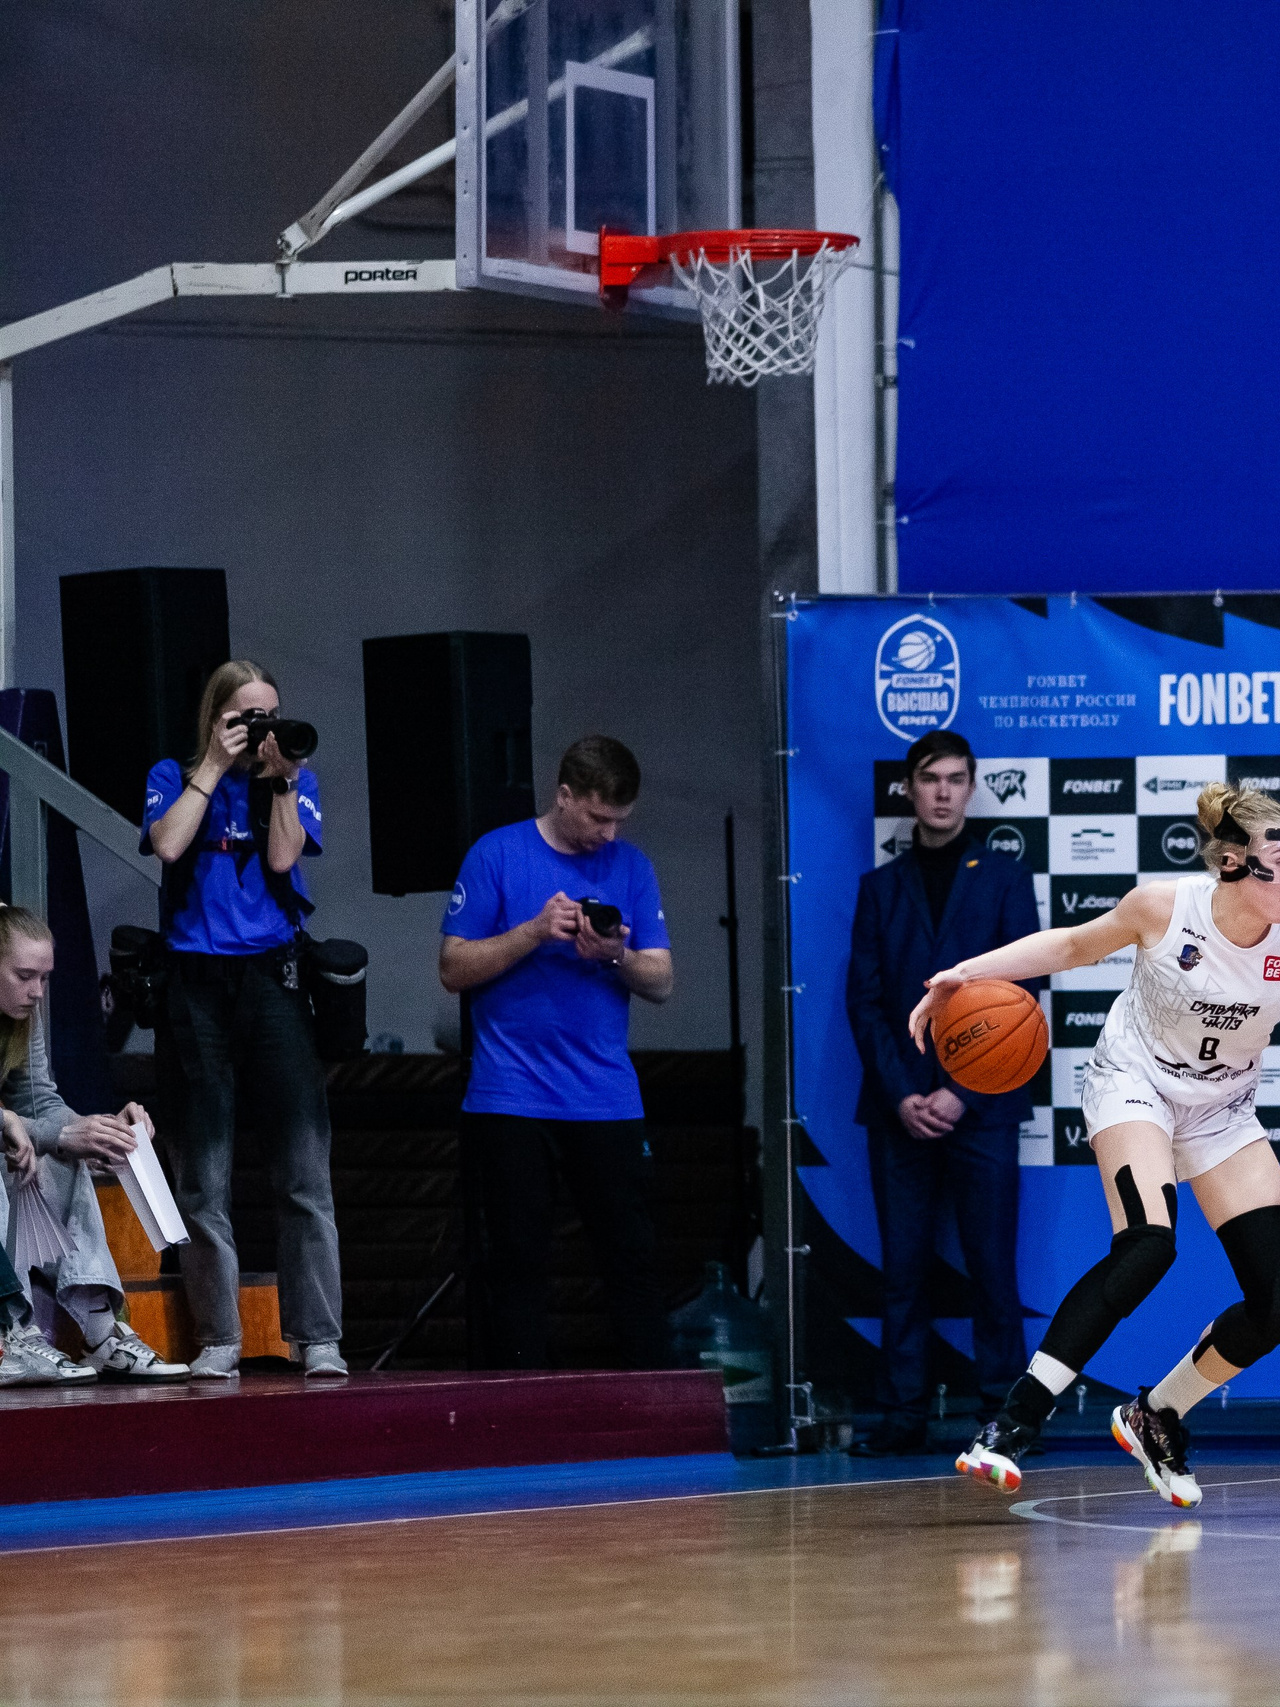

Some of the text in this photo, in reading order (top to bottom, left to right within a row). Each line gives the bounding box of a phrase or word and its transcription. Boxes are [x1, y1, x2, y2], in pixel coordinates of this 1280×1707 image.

[1027, 675, 1088, 688] FONBET
[887, 691, 949, 712] ВЫСШАЯ
[978, 694, 1137, 709] ЧЕМПИОНАТ РОССИИ
[994, 714, 1120, 728] ПО БАСКЕТБОЛУ
[1062, 779, 1123, 794] FONBET
[1182, 927, 1207, 942] MAXX
[1066, 1012, 1107, 1026] FONB
[1198, 1036, 1221, 1061] 8
[1125, 1098, 1154, 1108] MAXX
